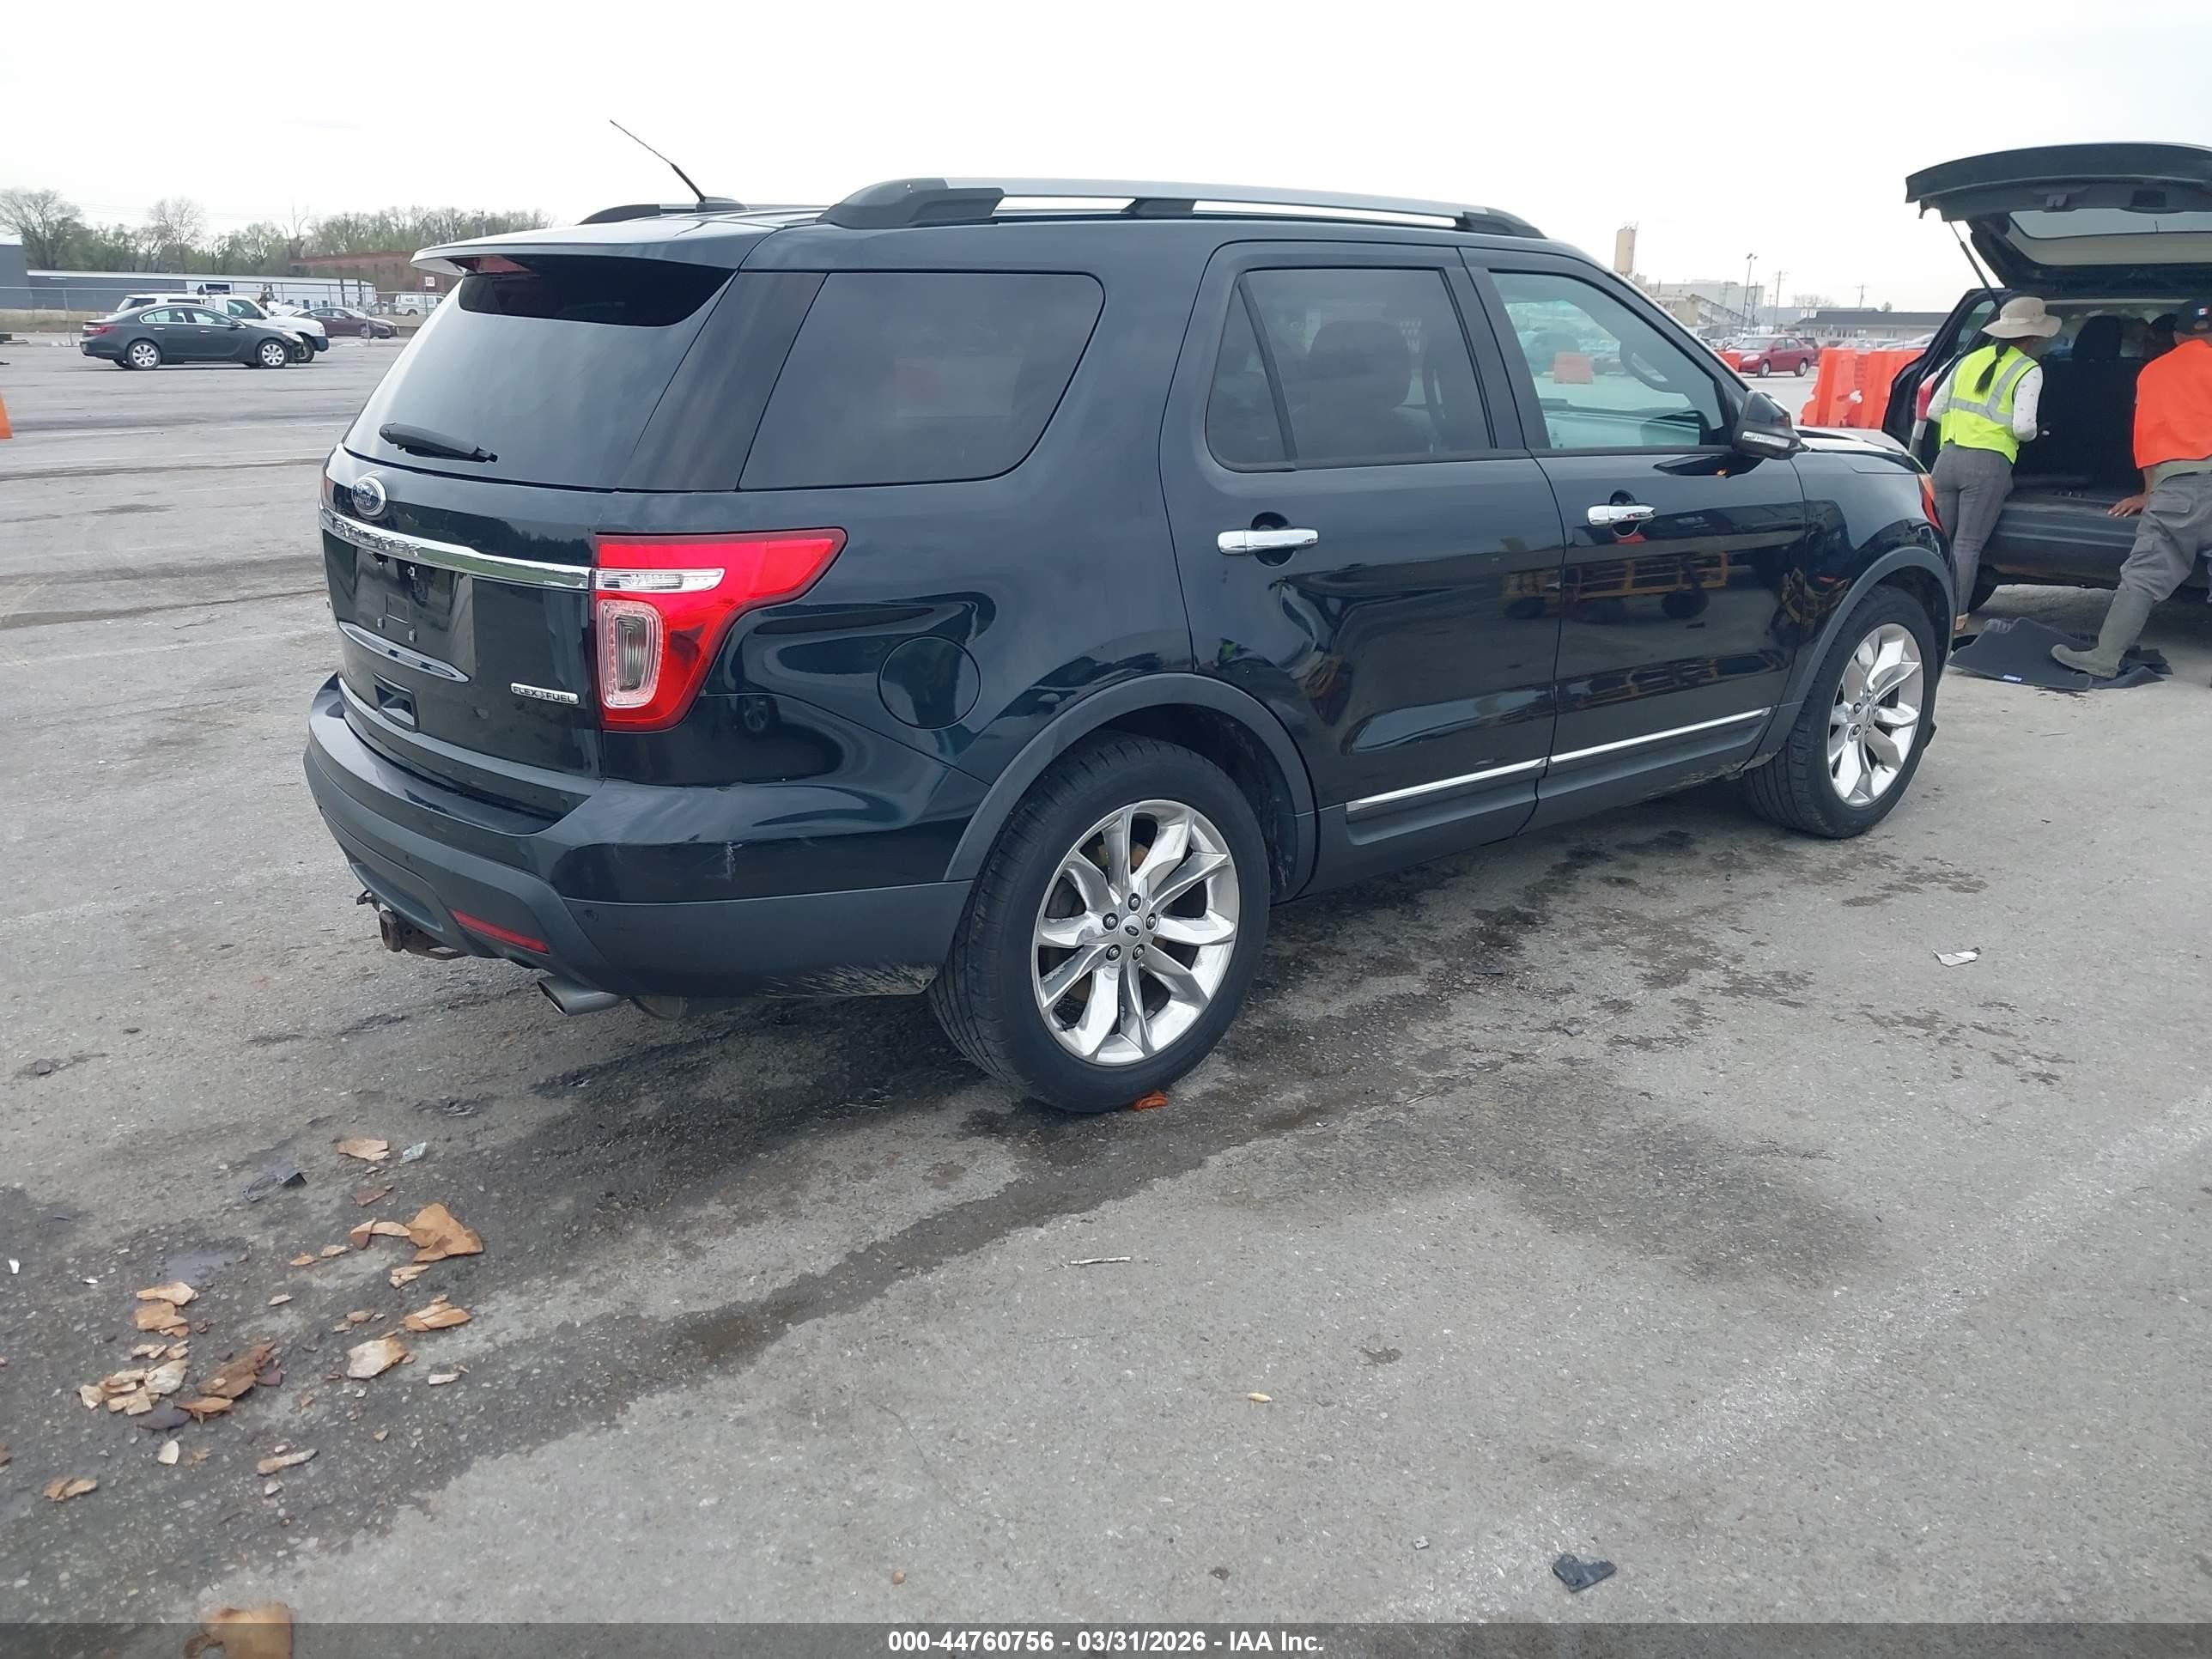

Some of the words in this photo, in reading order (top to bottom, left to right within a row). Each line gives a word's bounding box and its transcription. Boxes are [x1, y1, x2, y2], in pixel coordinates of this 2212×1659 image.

[355, 483, 375, 507] Ford
[513, 686, 538, 697] FLEX
[546, 692, 575, 703] FUEL
